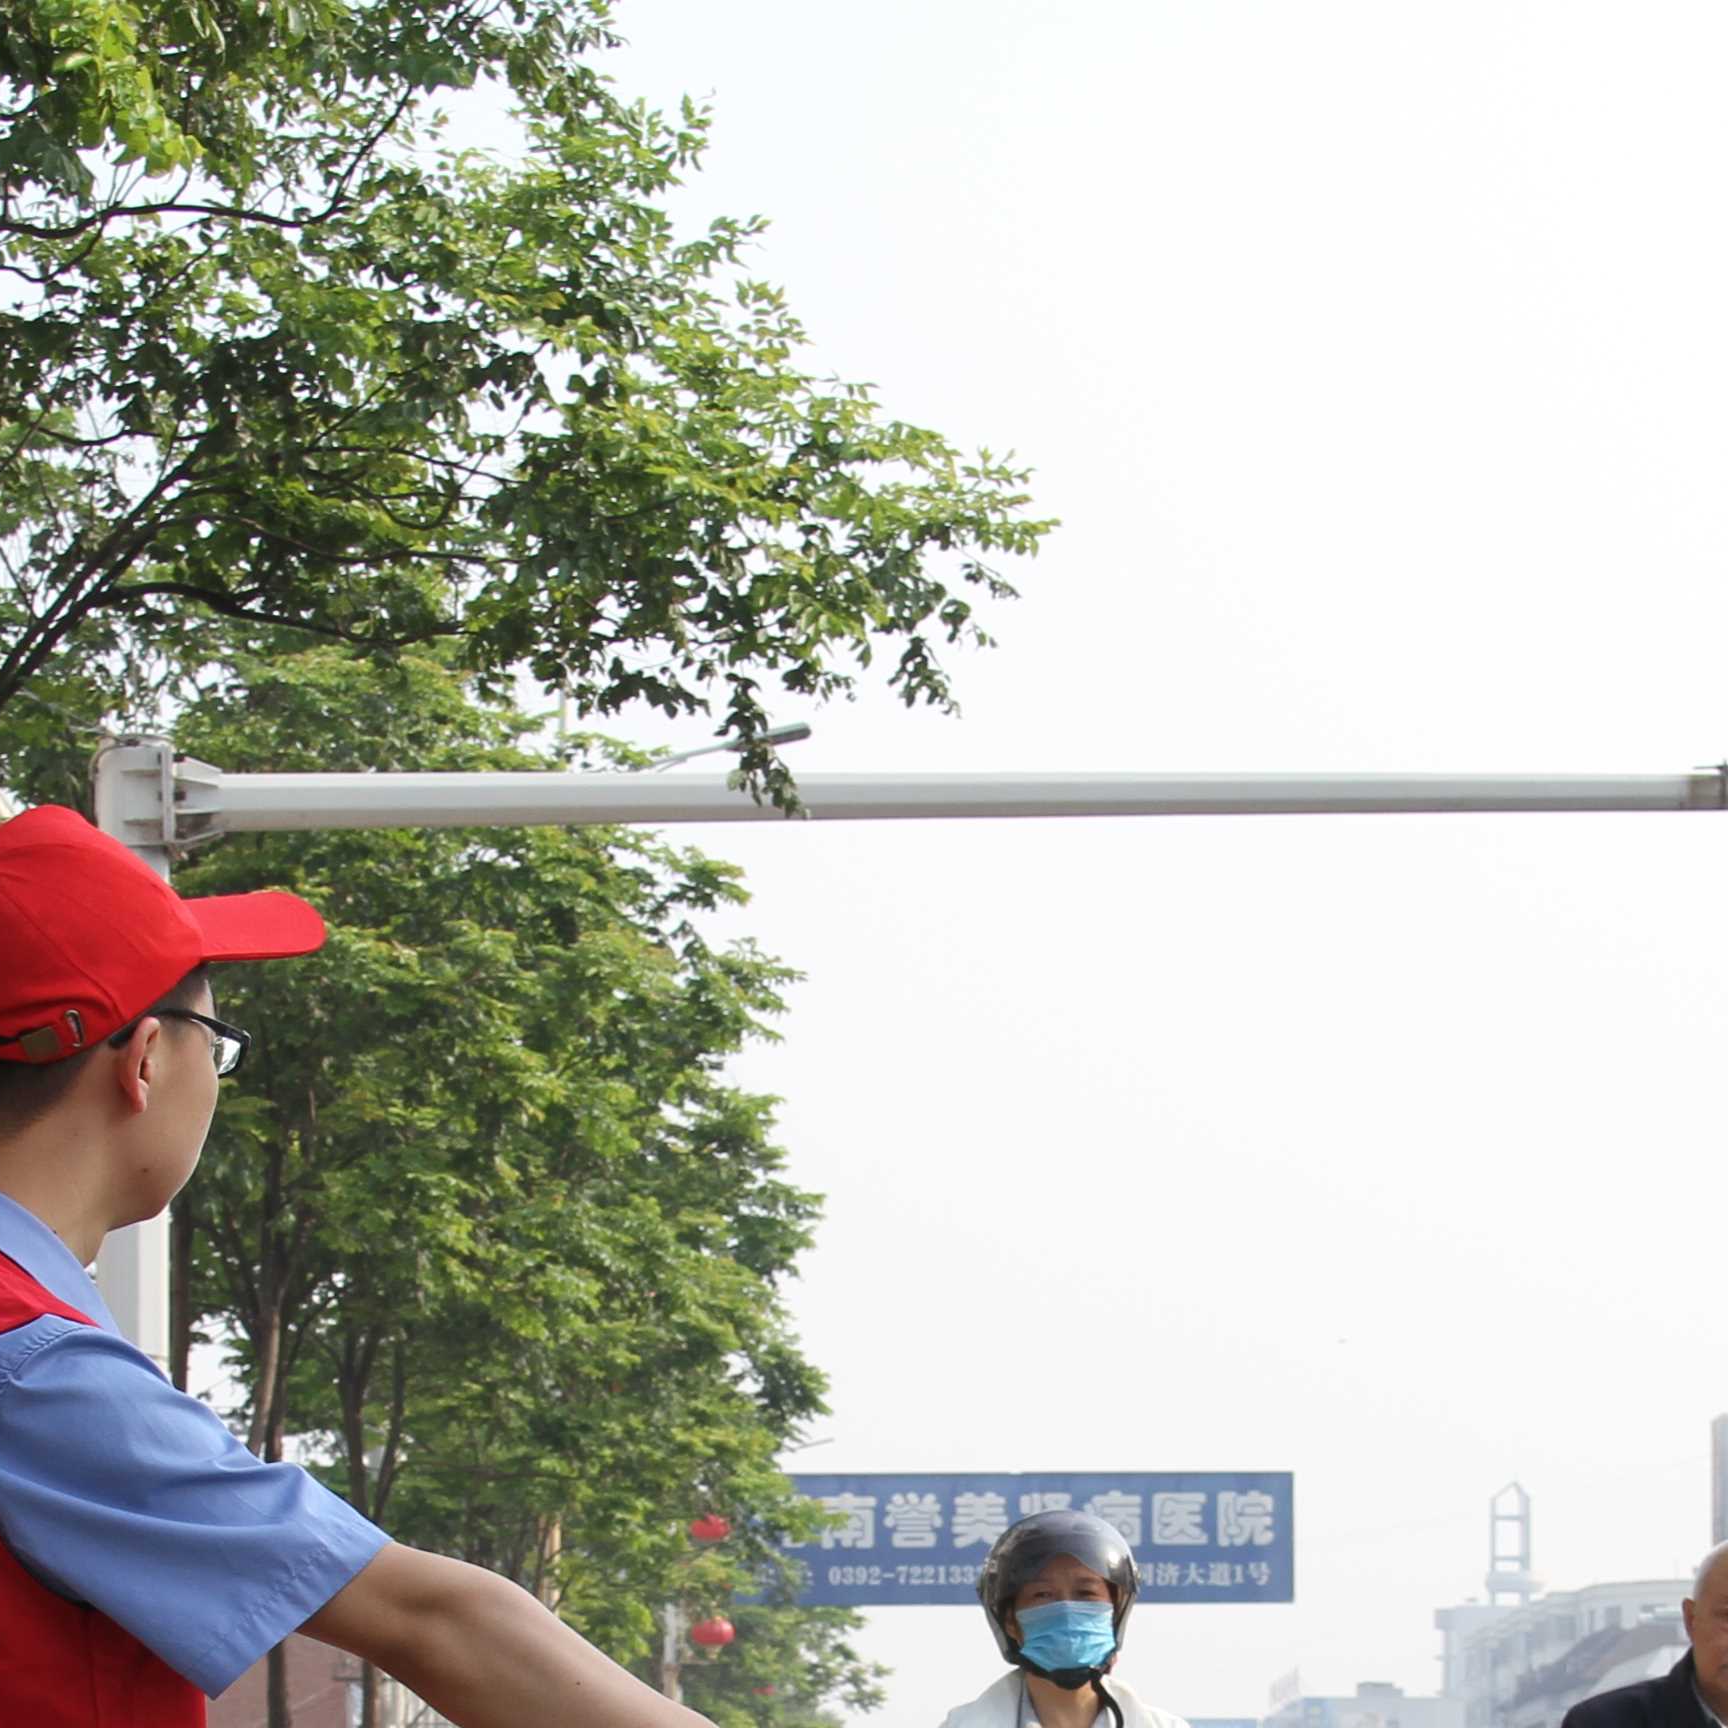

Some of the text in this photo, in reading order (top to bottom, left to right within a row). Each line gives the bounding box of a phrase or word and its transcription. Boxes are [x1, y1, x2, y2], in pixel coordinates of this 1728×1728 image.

[758, 1490, 1276, 1550] 南誉美病医院
